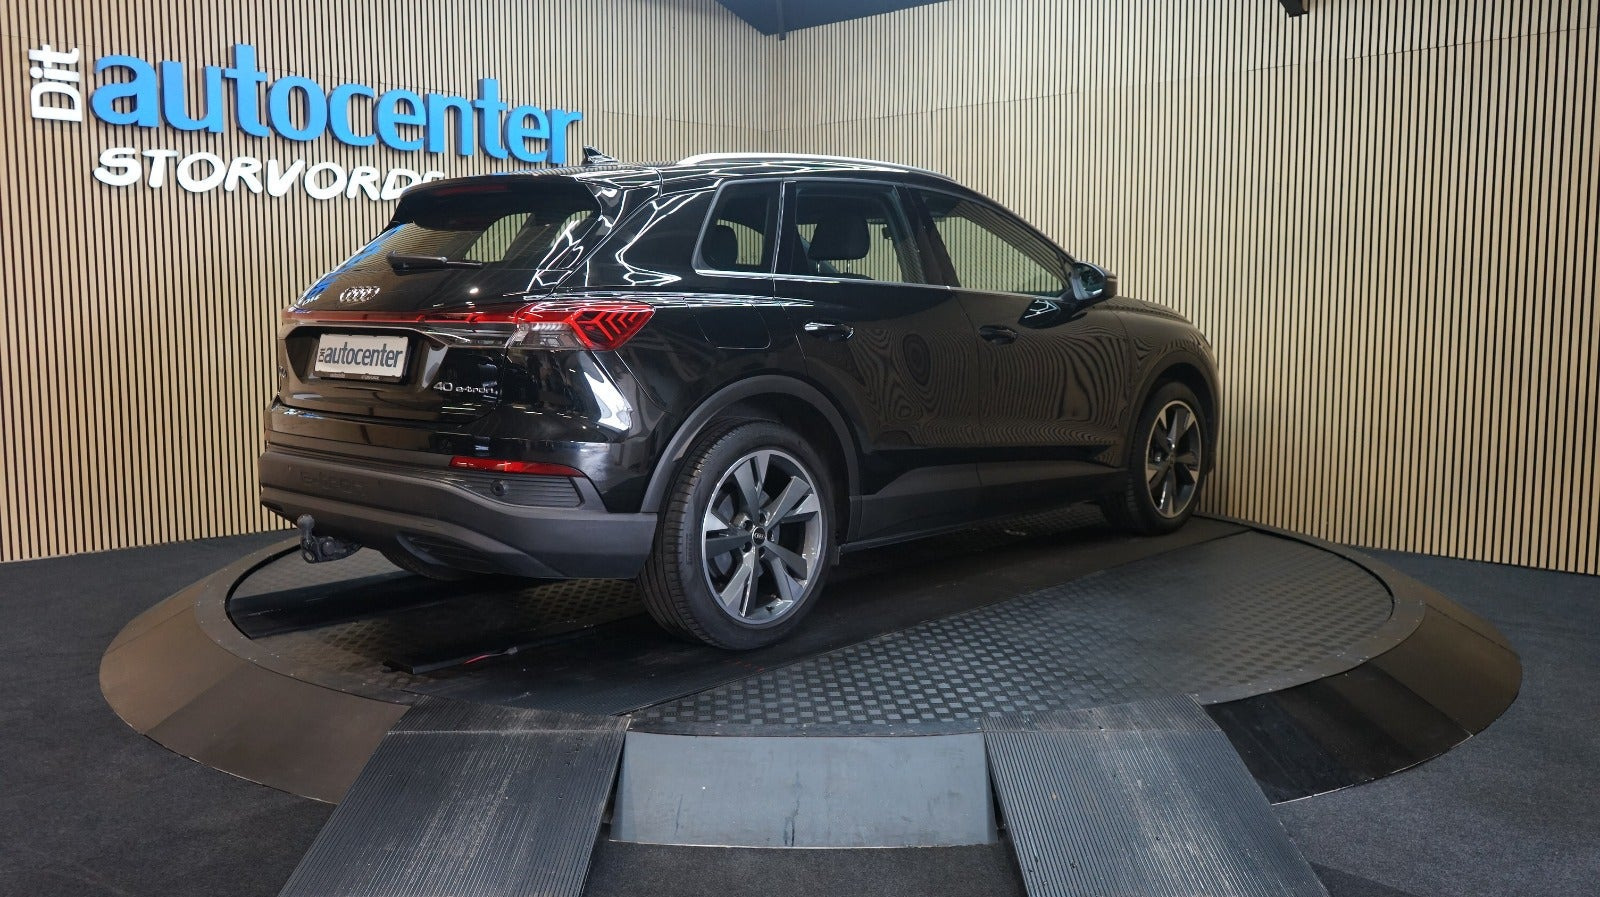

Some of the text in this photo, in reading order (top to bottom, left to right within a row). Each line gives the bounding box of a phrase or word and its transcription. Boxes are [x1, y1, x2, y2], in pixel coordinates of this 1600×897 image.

[28, 43, 583, 164] Dit autocenter
[324, 341, 403, 368] autocenter
[433, 381, 453, 392] 40
